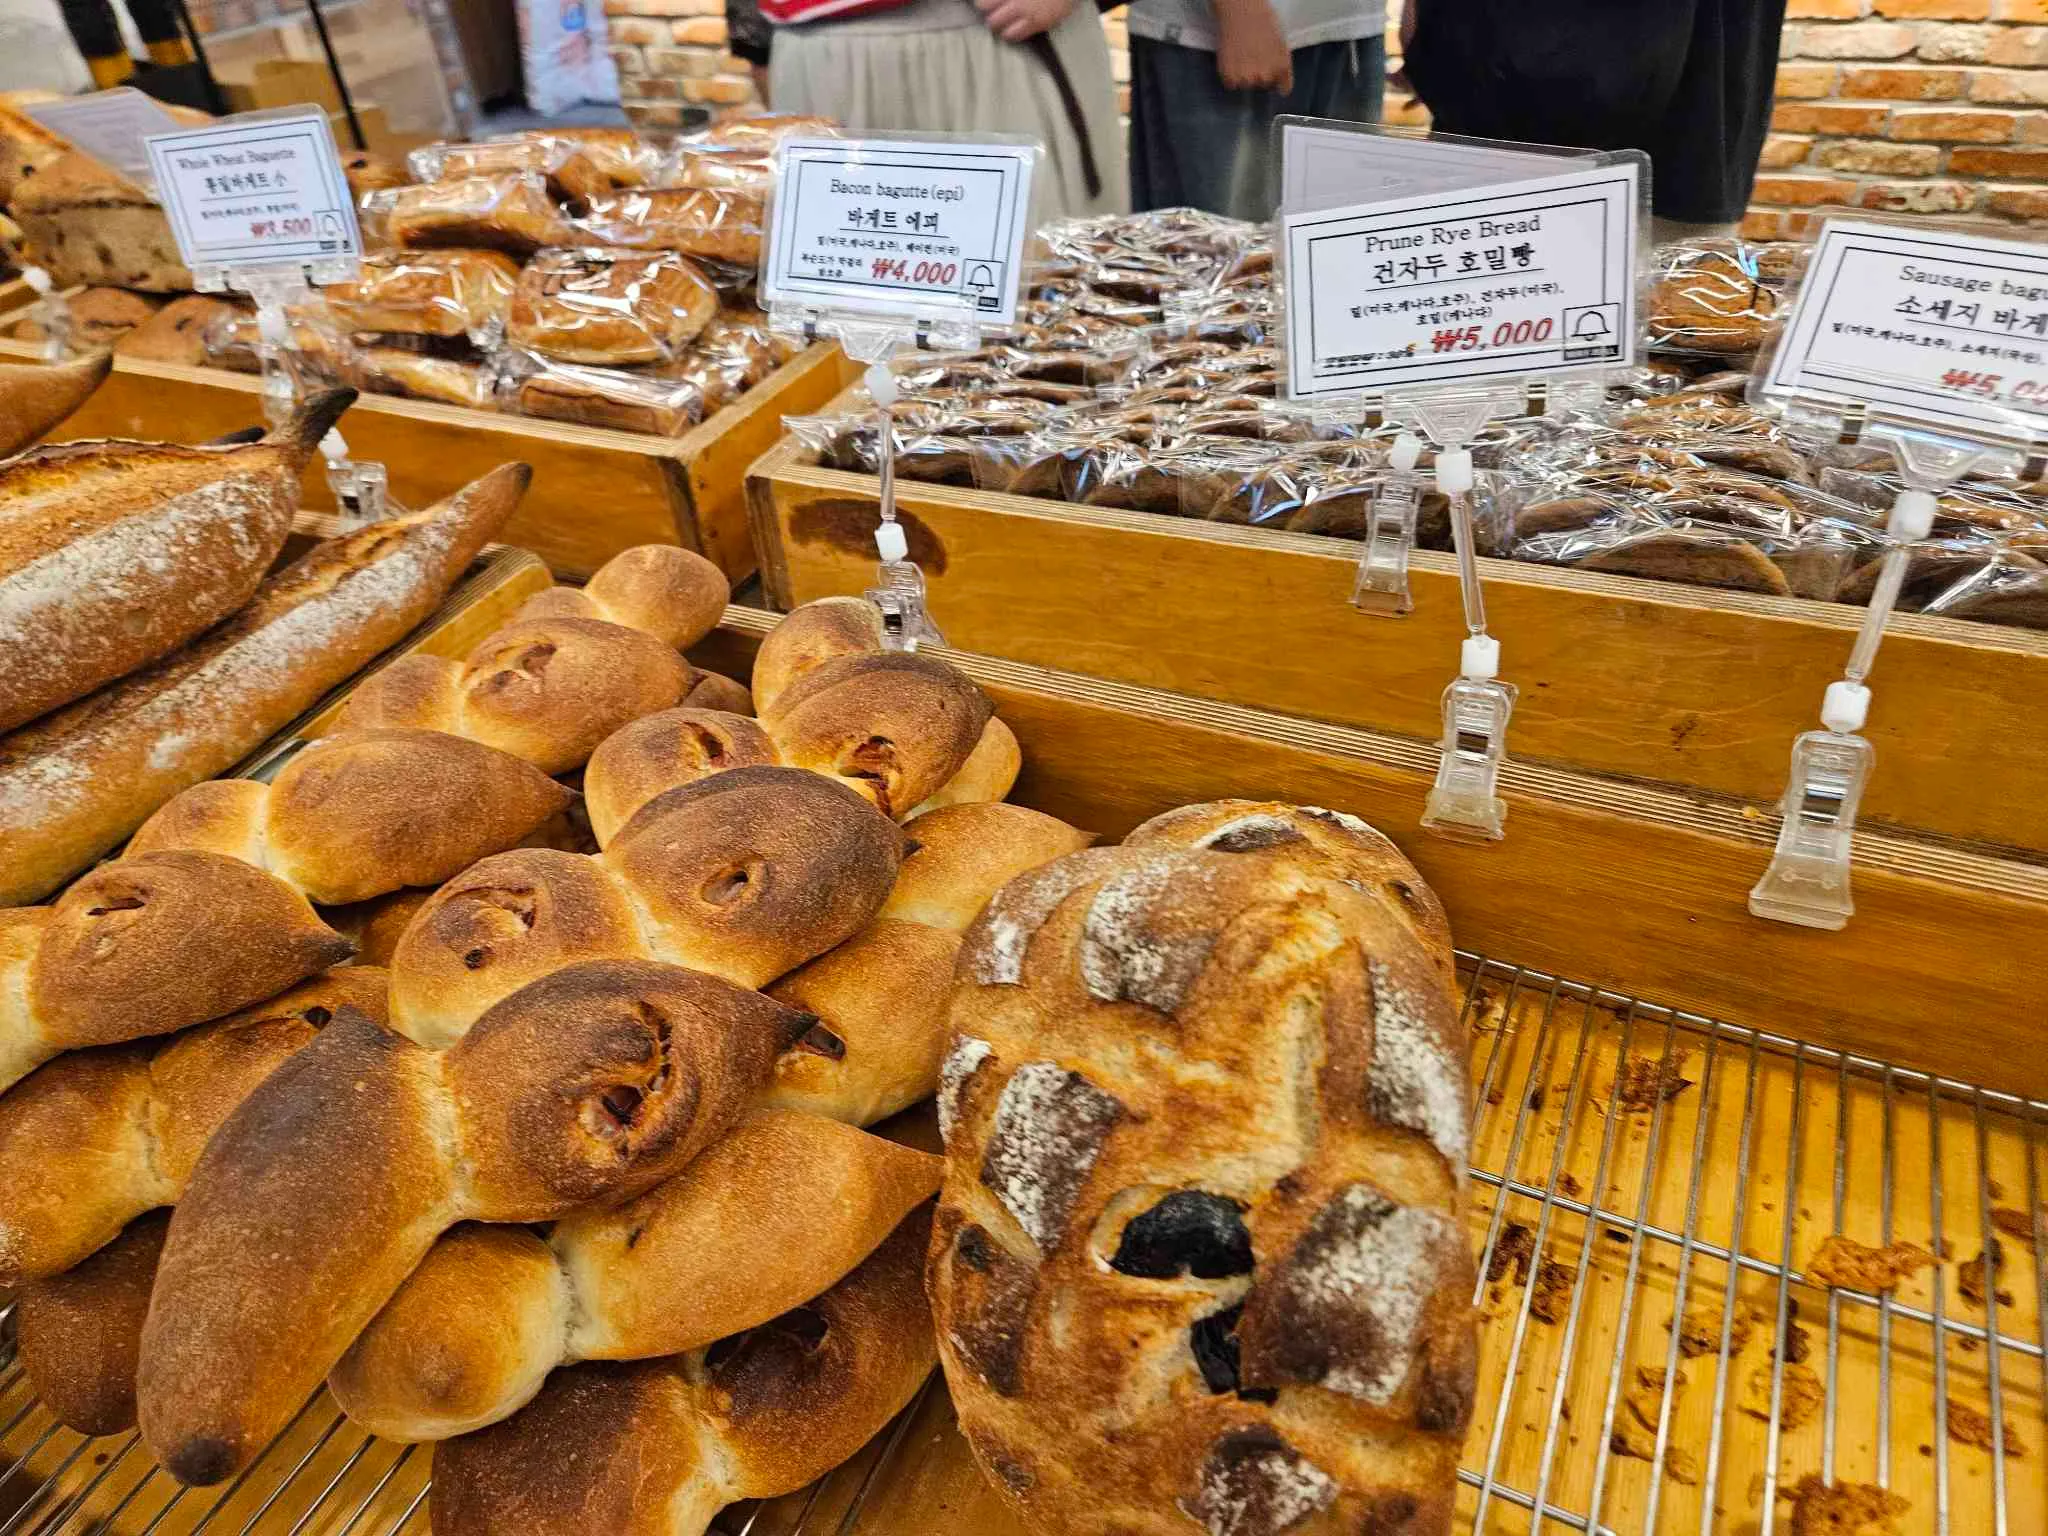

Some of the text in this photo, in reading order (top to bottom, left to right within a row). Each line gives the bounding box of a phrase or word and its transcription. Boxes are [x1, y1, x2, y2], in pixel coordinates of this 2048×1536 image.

[830, 179, 872, 196] Bacon
[848, 207, 939, 233] 바게트 에피
[1365, 215, 1541, 253] Prune Rye Bread
[871, 257, 957, 286] ₩4,000
[1373, 242, 1535, 284] 건자두 호밀빵
[1899, 265, 1993, 292] Sausage
[1894, 295, 1981, 326] 소세지
[1430, 317, 1553, 353] ₩5,000
